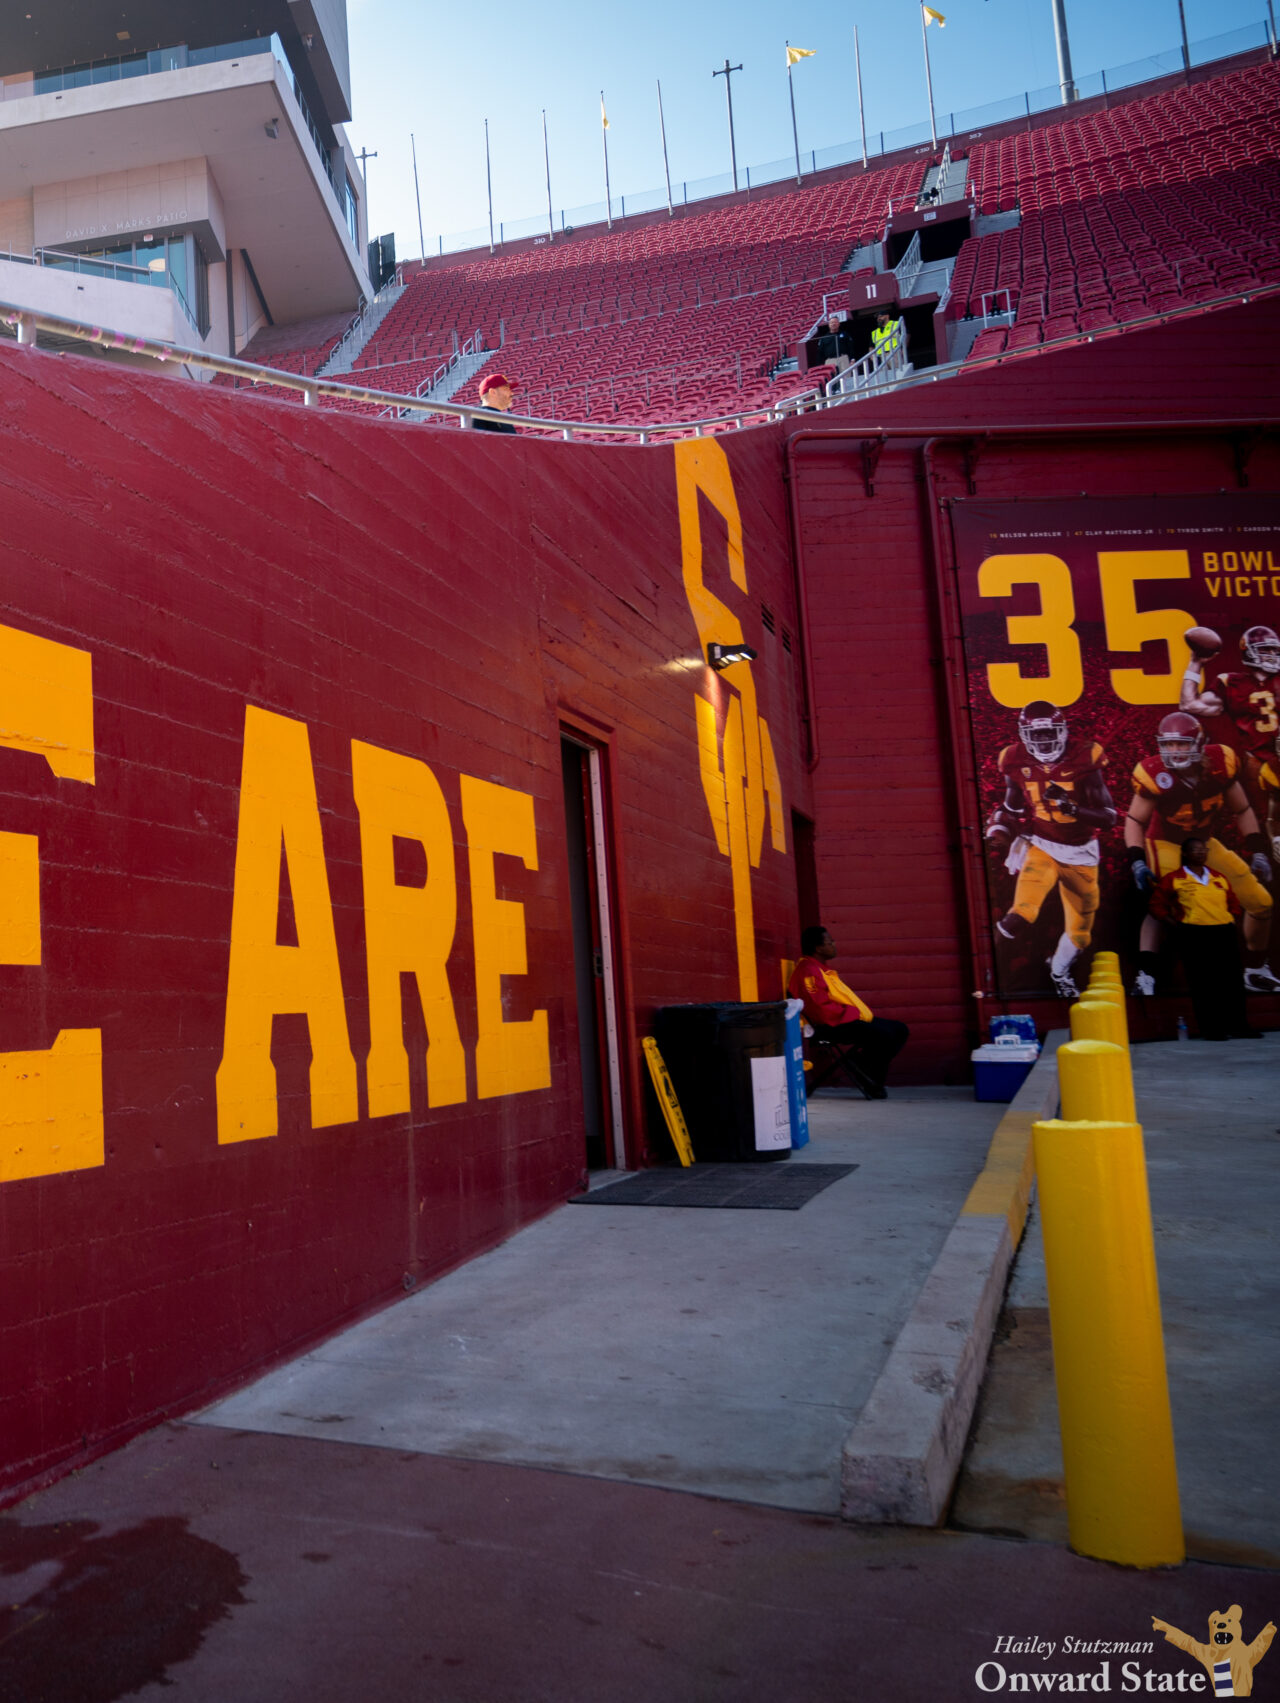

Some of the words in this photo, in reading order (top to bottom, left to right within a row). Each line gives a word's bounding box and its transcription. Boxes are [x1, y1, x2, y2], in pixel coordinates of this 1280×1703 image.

[65, 226, 96, 240] DAVID
[116, 216, 152, 231] MARKS
[156, 211, 188, 224] PATIO
[865, 284, 877, 299] 11
[1202, 550, 1280, 573] BOWL
[977, 550, 1205, 708] 35
[1249, 690, 1278, 733] 3
[215, 704, 551, 1145] ARE
